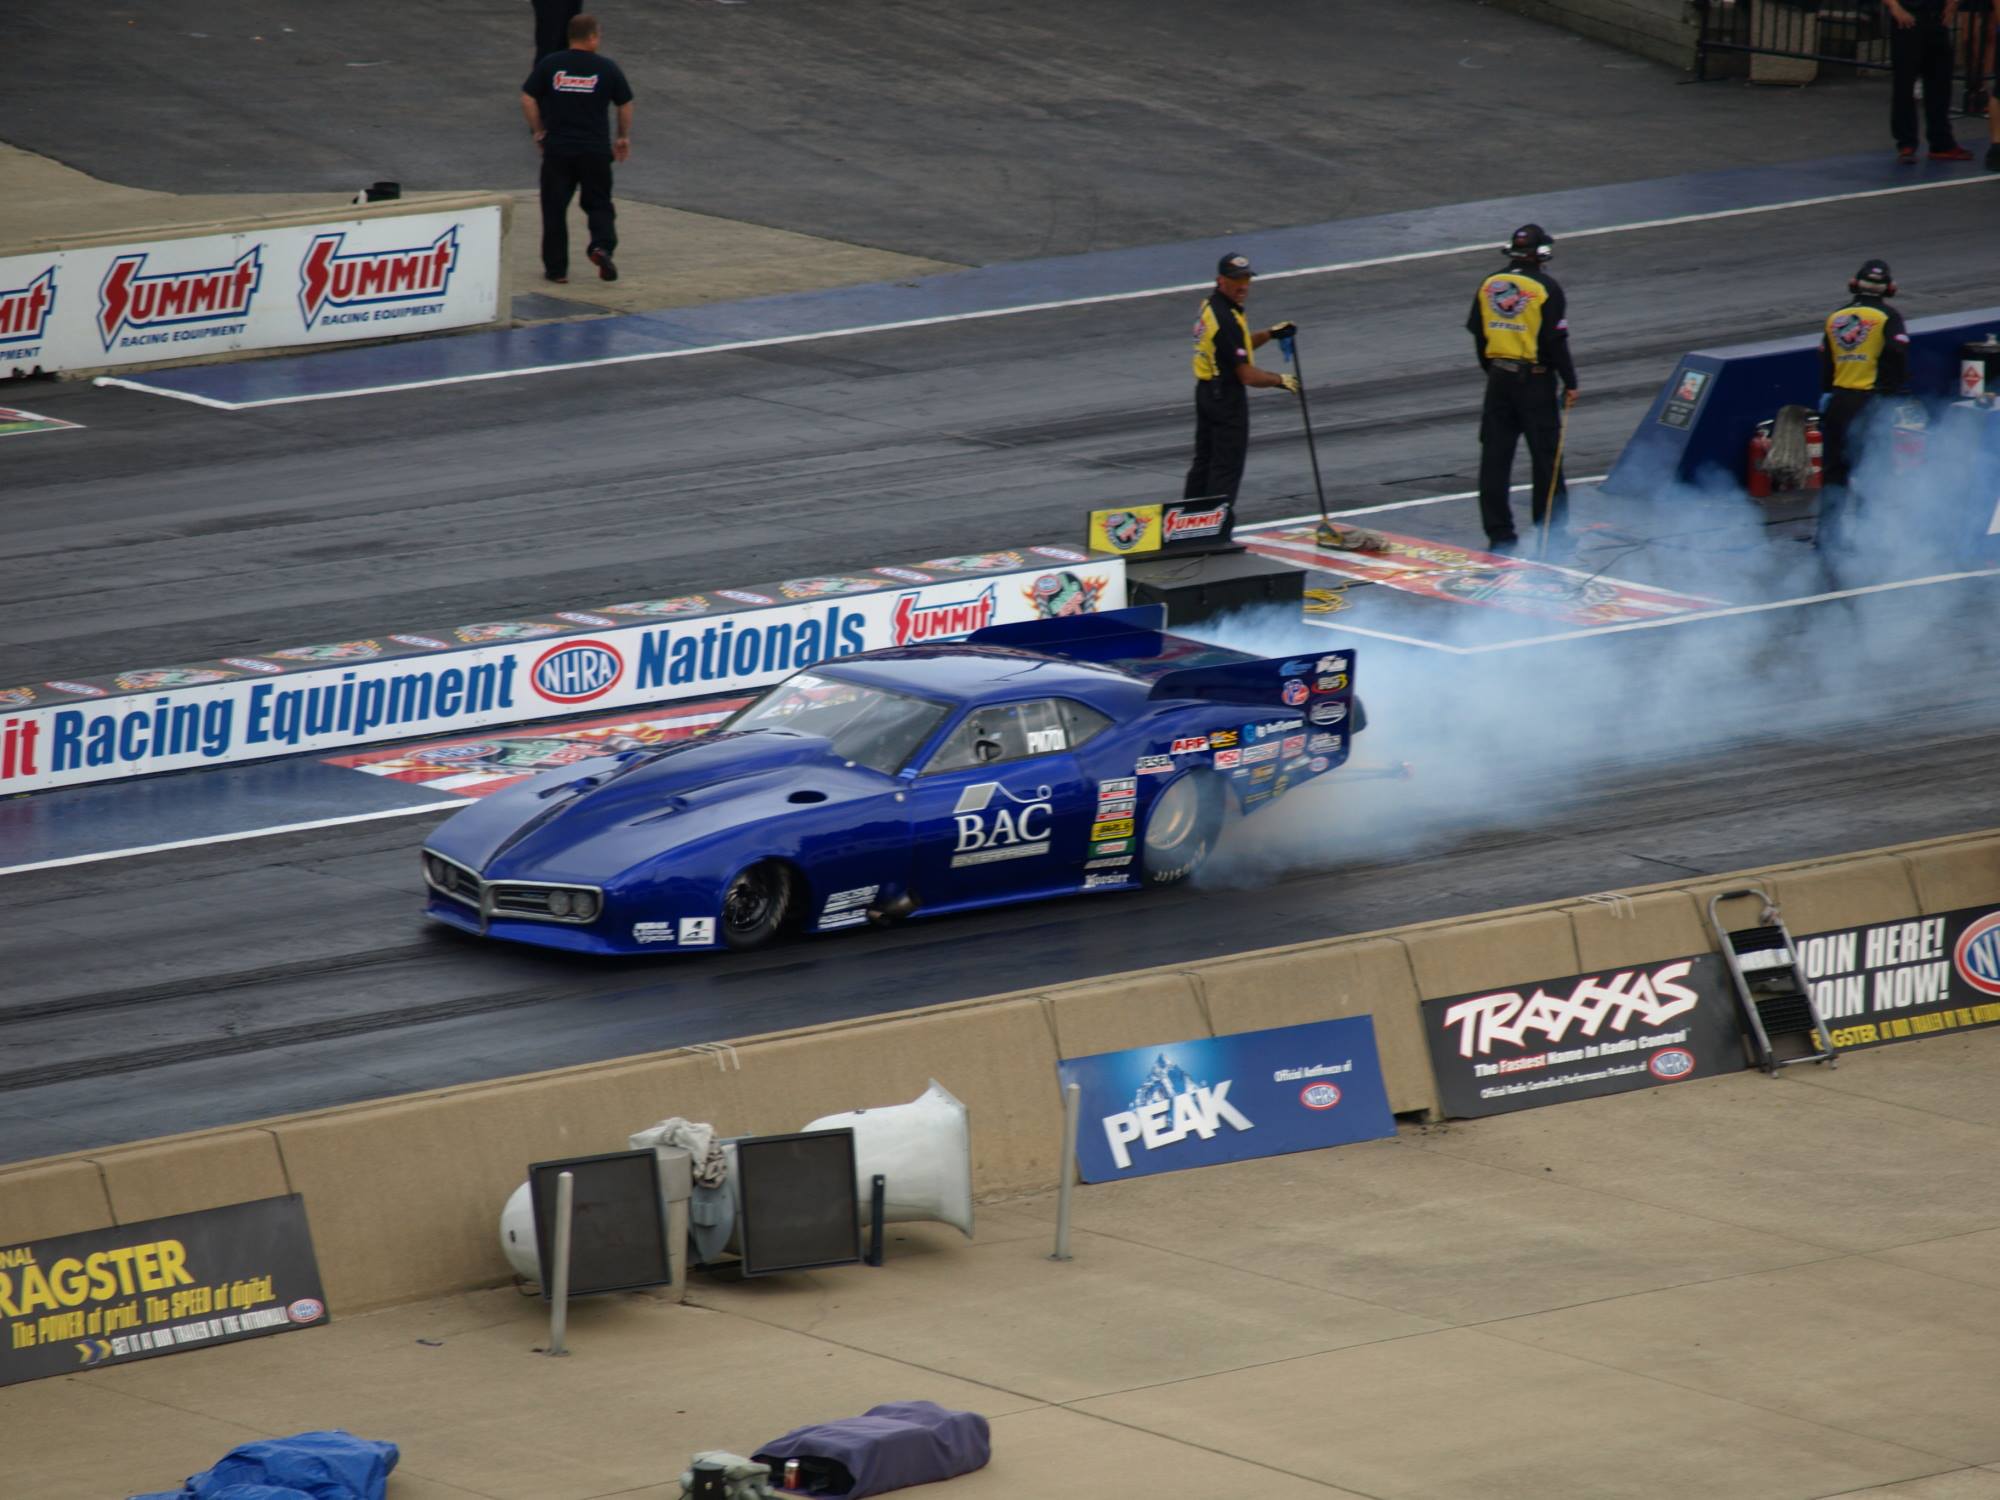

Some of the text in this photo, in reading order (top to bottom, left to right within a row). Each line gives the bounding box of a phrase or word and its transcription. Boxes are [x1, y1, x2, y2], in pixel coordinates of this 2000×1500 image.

[120, 324, 247, 347] RACING EQUIPMENT
[321, 303, 445, 326] RACING EQUIPMENT
[2, 607, 865, 778] it Racing Equipment NHRA Nationals
[1173, 737, 1208, 752] ARP
[953, 804, 1053, 852] BAC
[1865, 917, 1945, 969] HERE!
[1444, 961, 1699, 1058] TRAXXAS
[1873, 960, 1950, 1012] NOW!
[1475, 1062, 1498, 1077] The
[1103, 1080, 1254, 1169] PEAK
[12, 1322, 36, 1349] The
[39, 1311, 84, 1344] POWER
[88, 1307, 102, 1334] of
[104, 1300, 141, 1336] print.
[146, 1296, 168, 1323] The
[171, 1286, 211, 1318] SPEED
[214, 1282, 229, 1310] of
[230, 1274, 276, 1309] digital.
